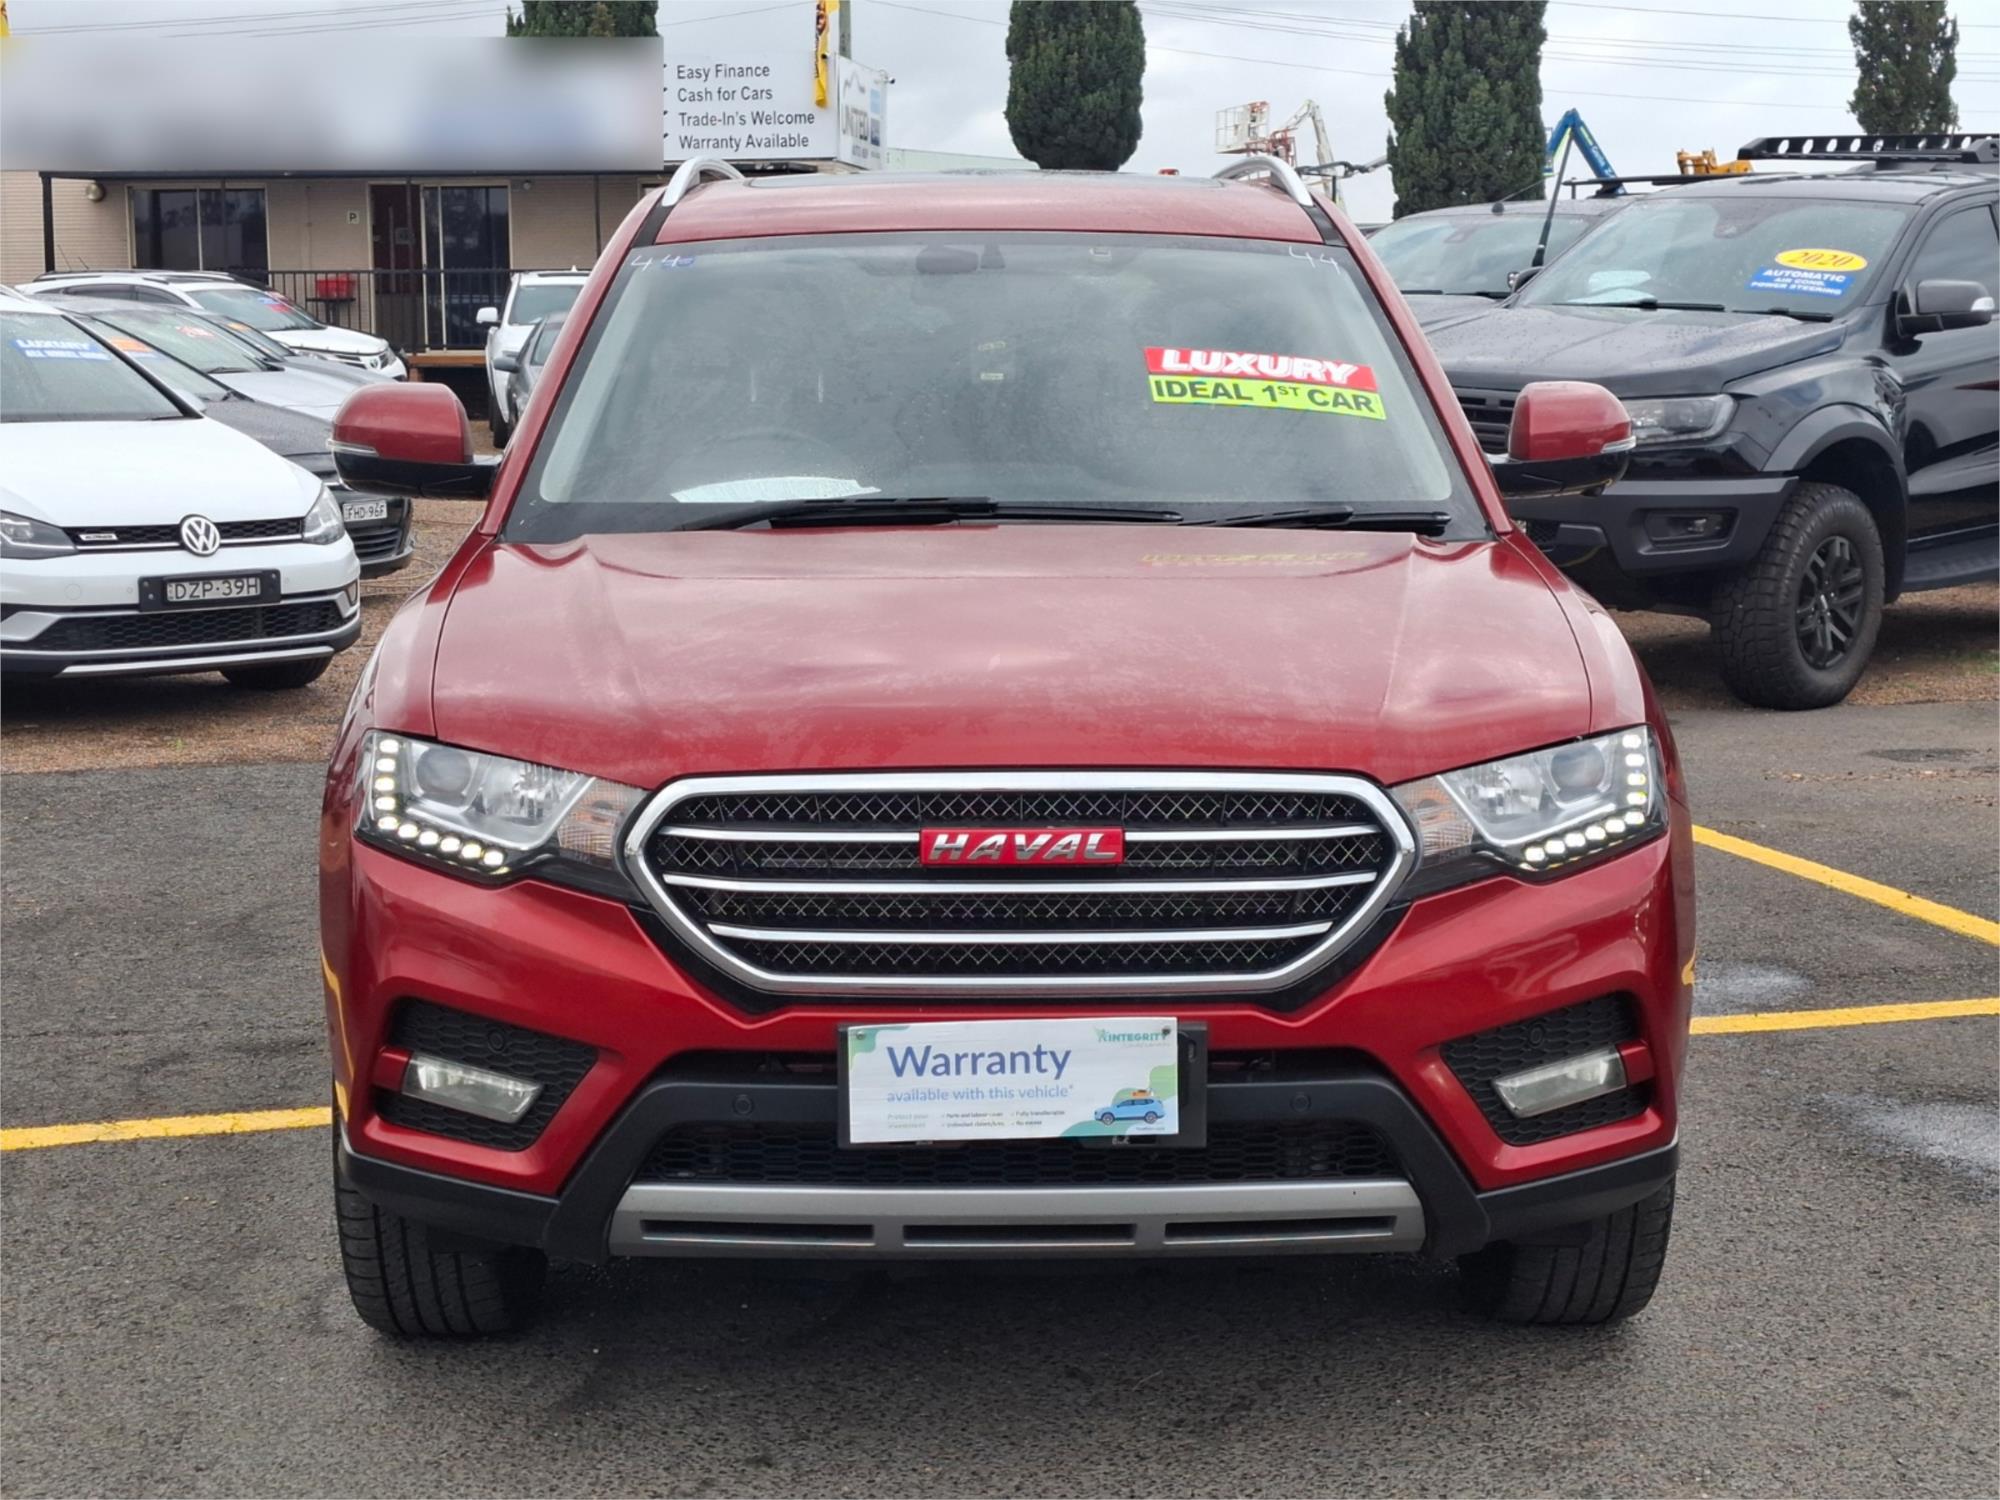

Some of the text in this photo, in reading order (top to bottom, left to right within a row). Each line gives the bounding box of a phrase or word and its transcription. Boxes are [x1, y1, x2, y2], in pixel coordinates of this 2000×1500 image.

[677, 63, 770, 82] Easy Finance
[677, 86, 773, 102] Cash for Cars
[679, 110, 815, 127] Trade-In's Welcome
[679, 133, 809, 152] Warranty Available
[1787, 251, 1854, 267] 2020
[1762, 269, 1846, 283] AUTOMATIC
[1750, 281, 1843, 295] POWER STEERING
[1161, 348, 1359, 385] LUXURY
[1154, 379, 1254, 401] IDEAL
[1307, 389, 1376, 413] CAR
[928, 832, 1117, 861] HAVAL
[886, 1043, 1071, 1080] Warranty
[887, 1088, 949, 1103] available
[953, 1087, 985, 1101] with
[988, 1086, 1015, 1100] this
